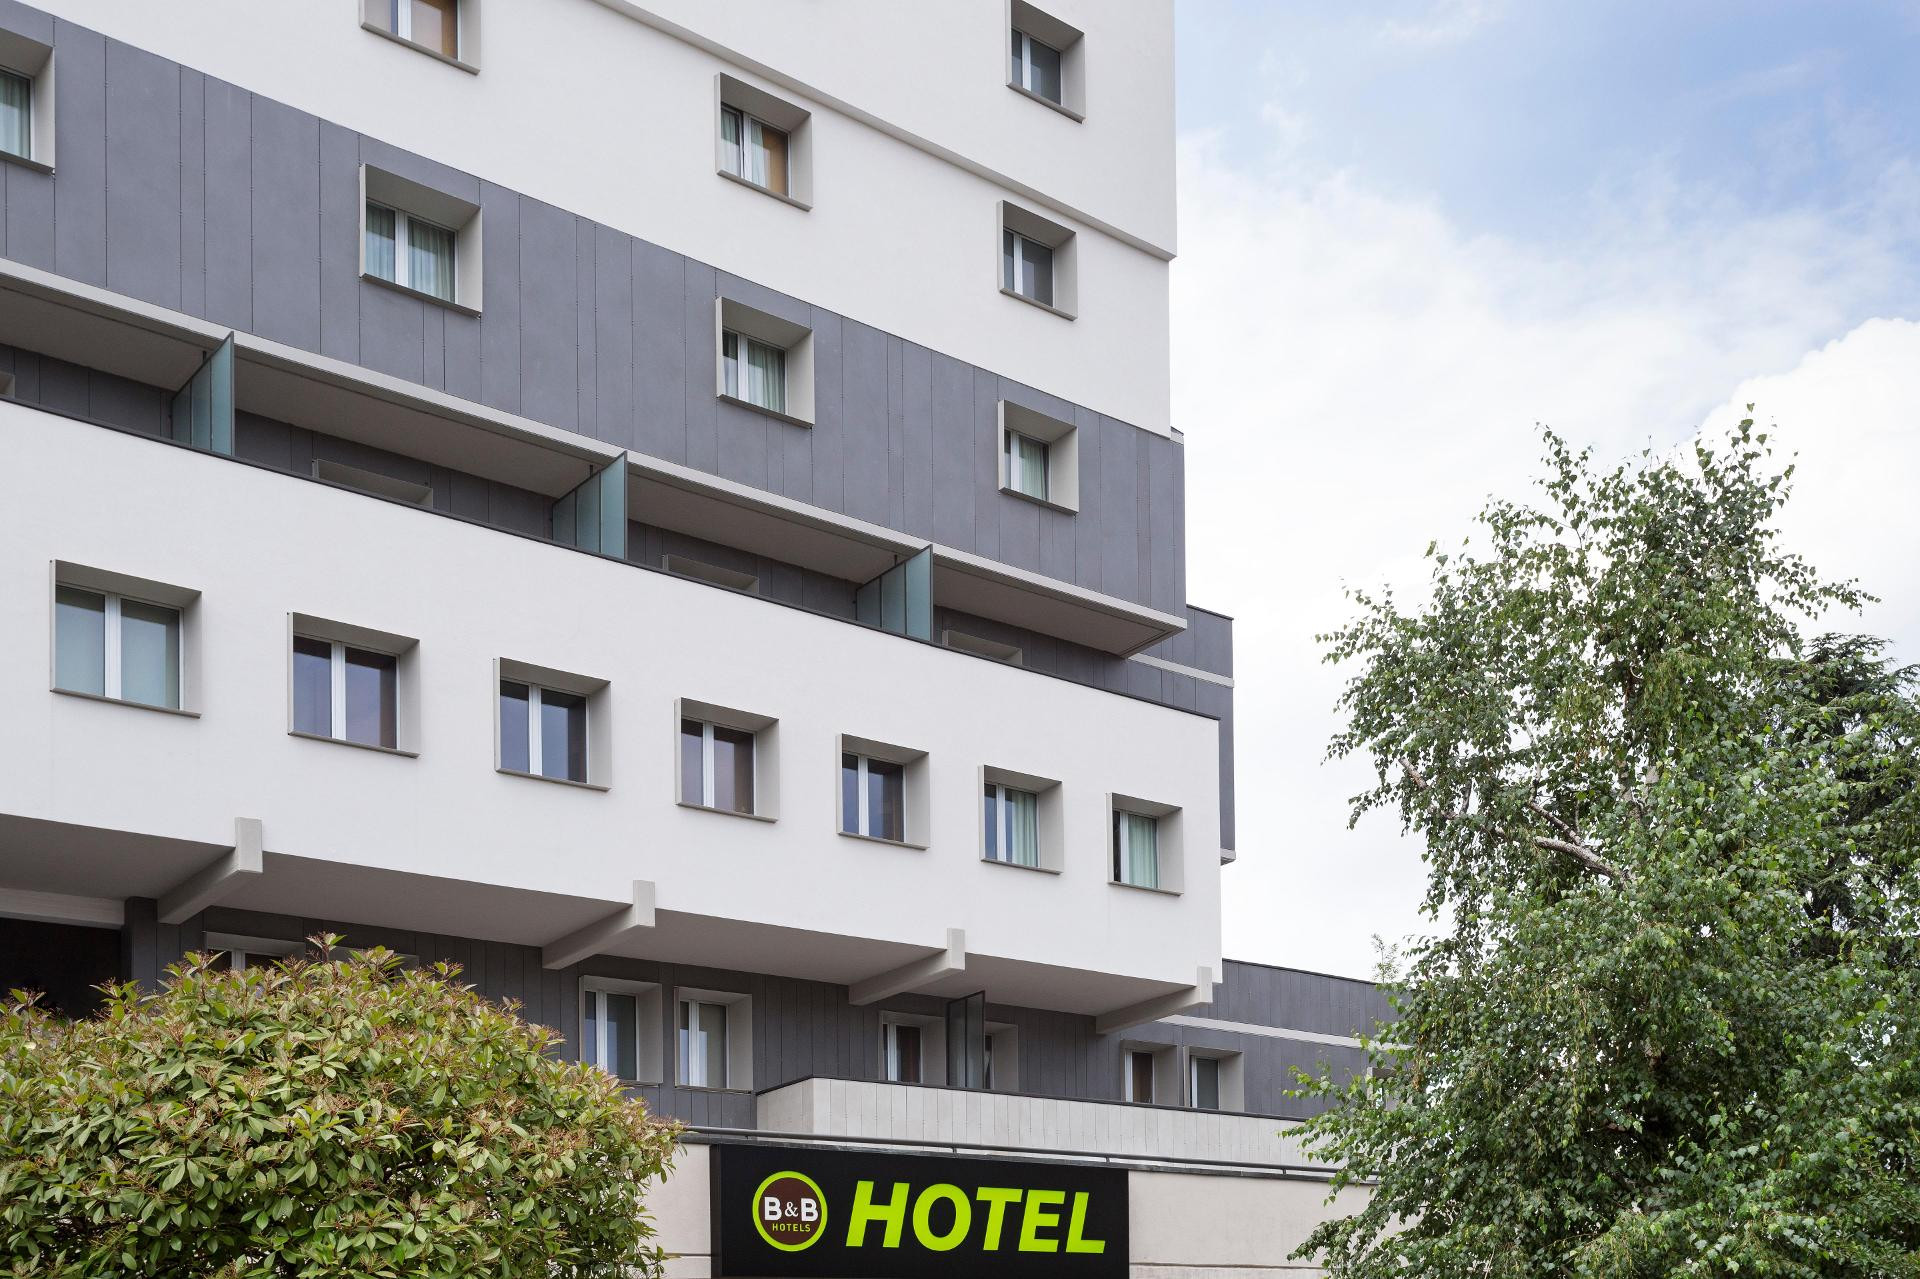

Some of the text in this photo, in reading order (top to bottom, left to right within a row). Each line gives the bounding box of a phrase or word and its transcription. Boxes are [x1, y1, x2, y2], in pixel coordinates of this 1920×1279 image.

[764, 1196, 819, 1222] B&B
[845, 1180, 1106, 1254] HOTEL
[772, 1223, 811, 1232] HOTELS
